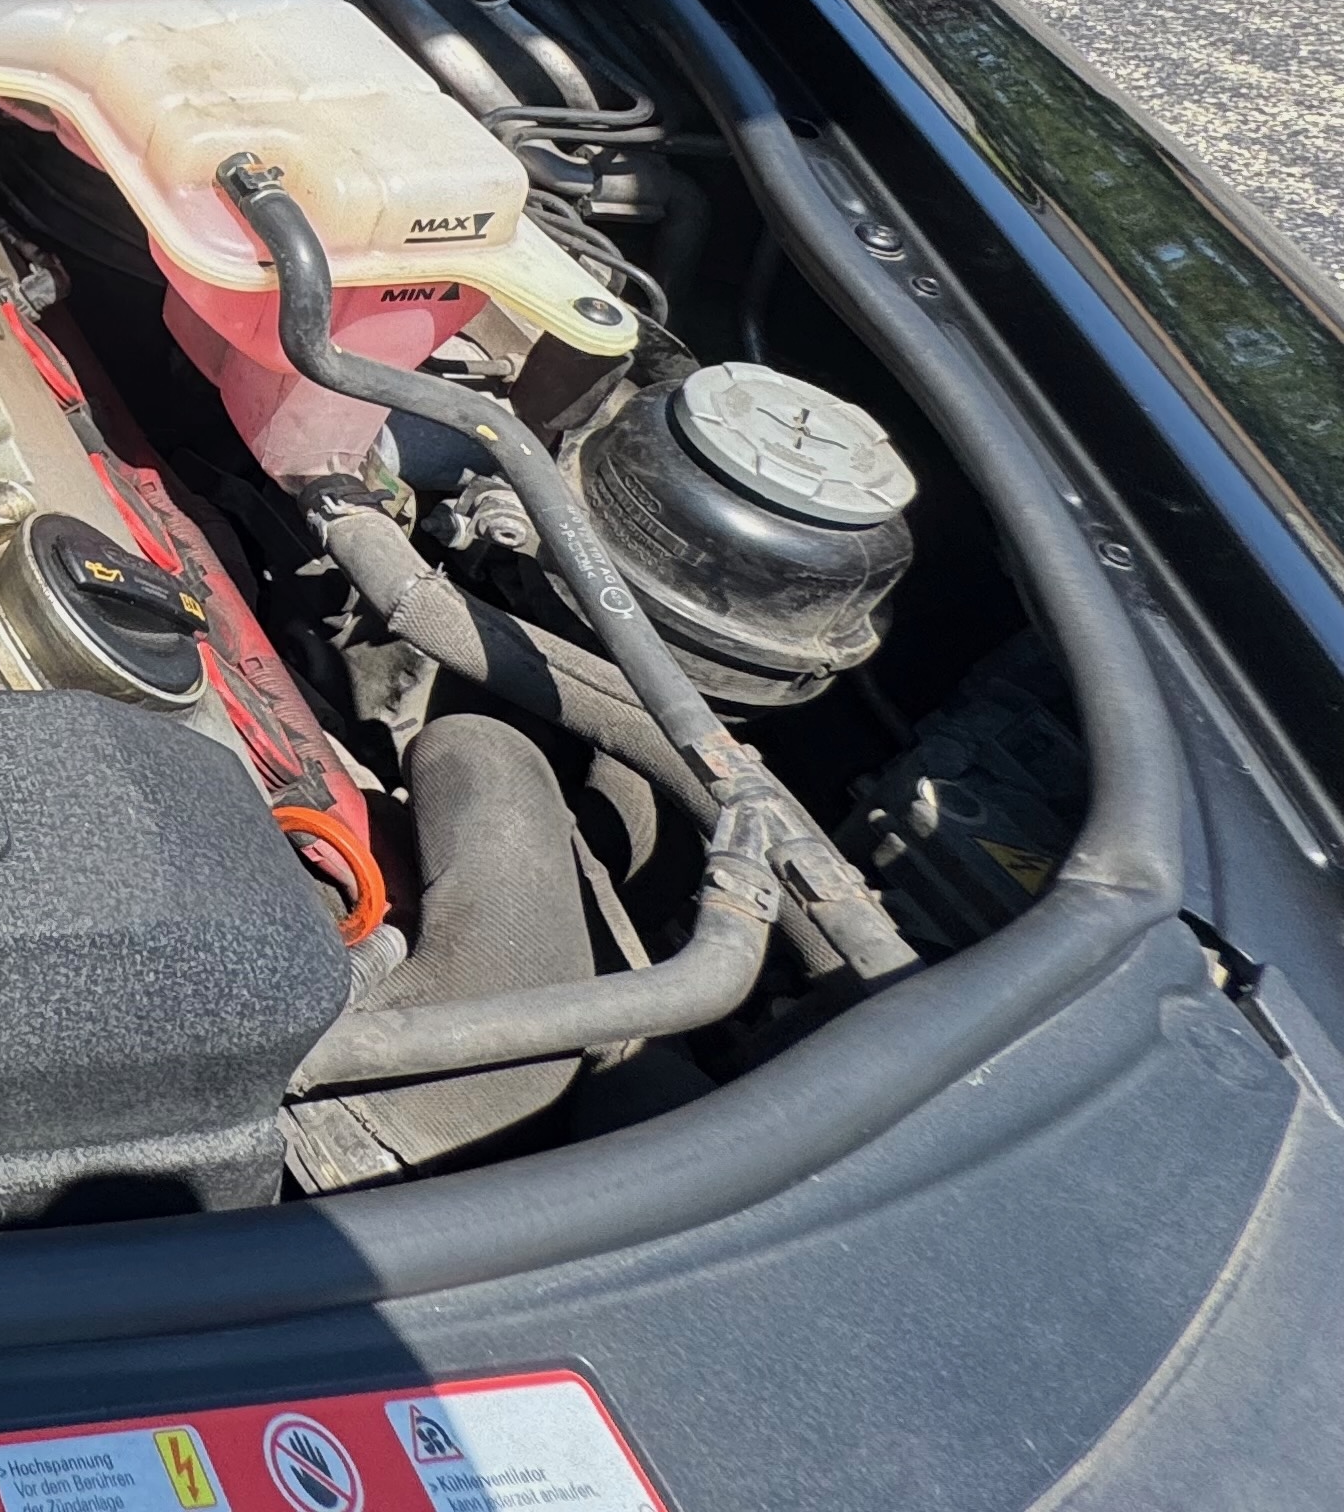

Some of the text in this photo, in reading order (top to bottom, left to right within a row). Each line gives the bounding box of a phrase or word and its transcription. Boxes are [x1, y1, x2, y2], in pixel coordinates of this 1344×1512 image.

[410, 216, 471, 233] MAX
[380, 287, 436, 302] MIN
[7, 1453, 116, 1478] Hochspannung
[14, 1471, 136, 1500] Vor dem Berühren
[436, 1466, 548, 1493] Kühlerventilator
[47, 1494, 126, 1512] Zündanlage
